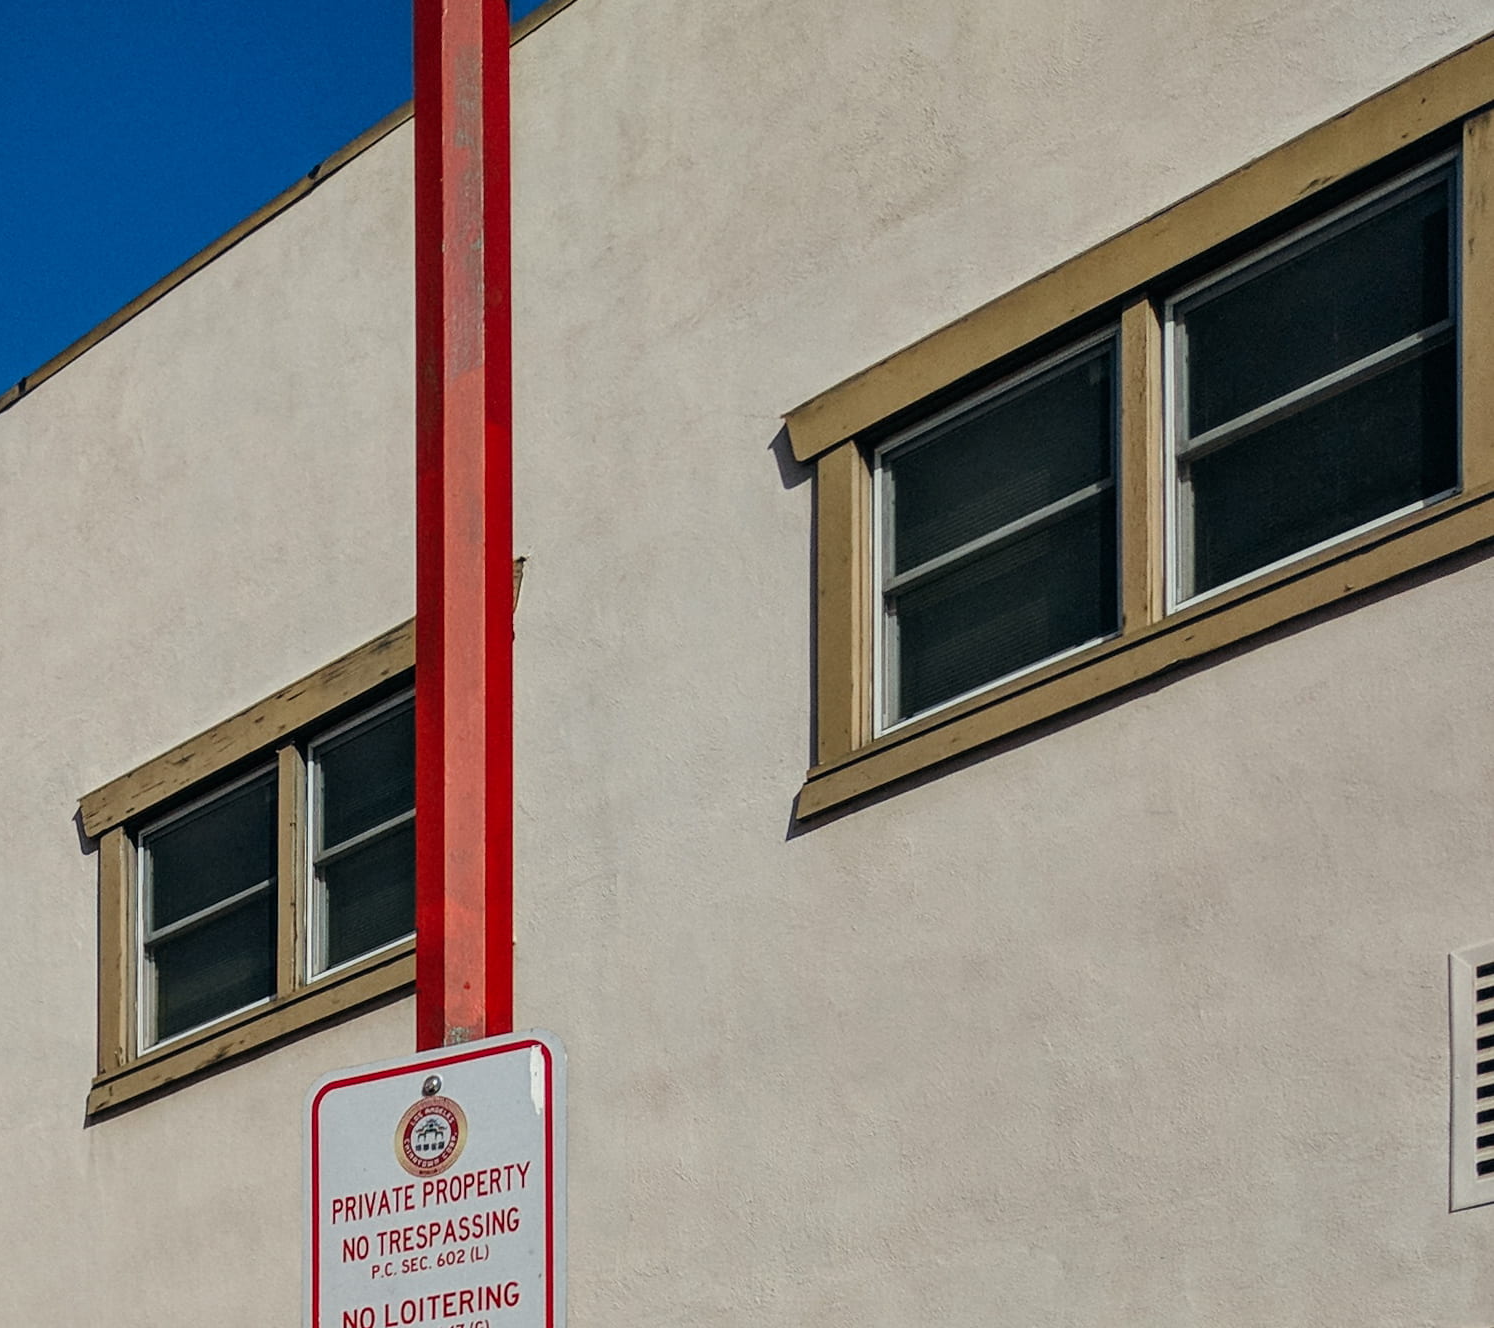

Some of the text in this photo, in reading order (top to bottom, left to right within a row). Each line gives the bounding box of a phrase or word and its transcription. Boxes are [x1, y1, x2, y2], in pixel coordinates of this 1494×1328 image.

[331, 1160, 531, 1225] PRIVATE PROPERTY
[342, 1206, 520, 1263] NO TRESPASSING
[371, 1244, 490, 1279] P.C. SEC. 602 (L)
[384, 1281, 520, 1328] LOITERING
